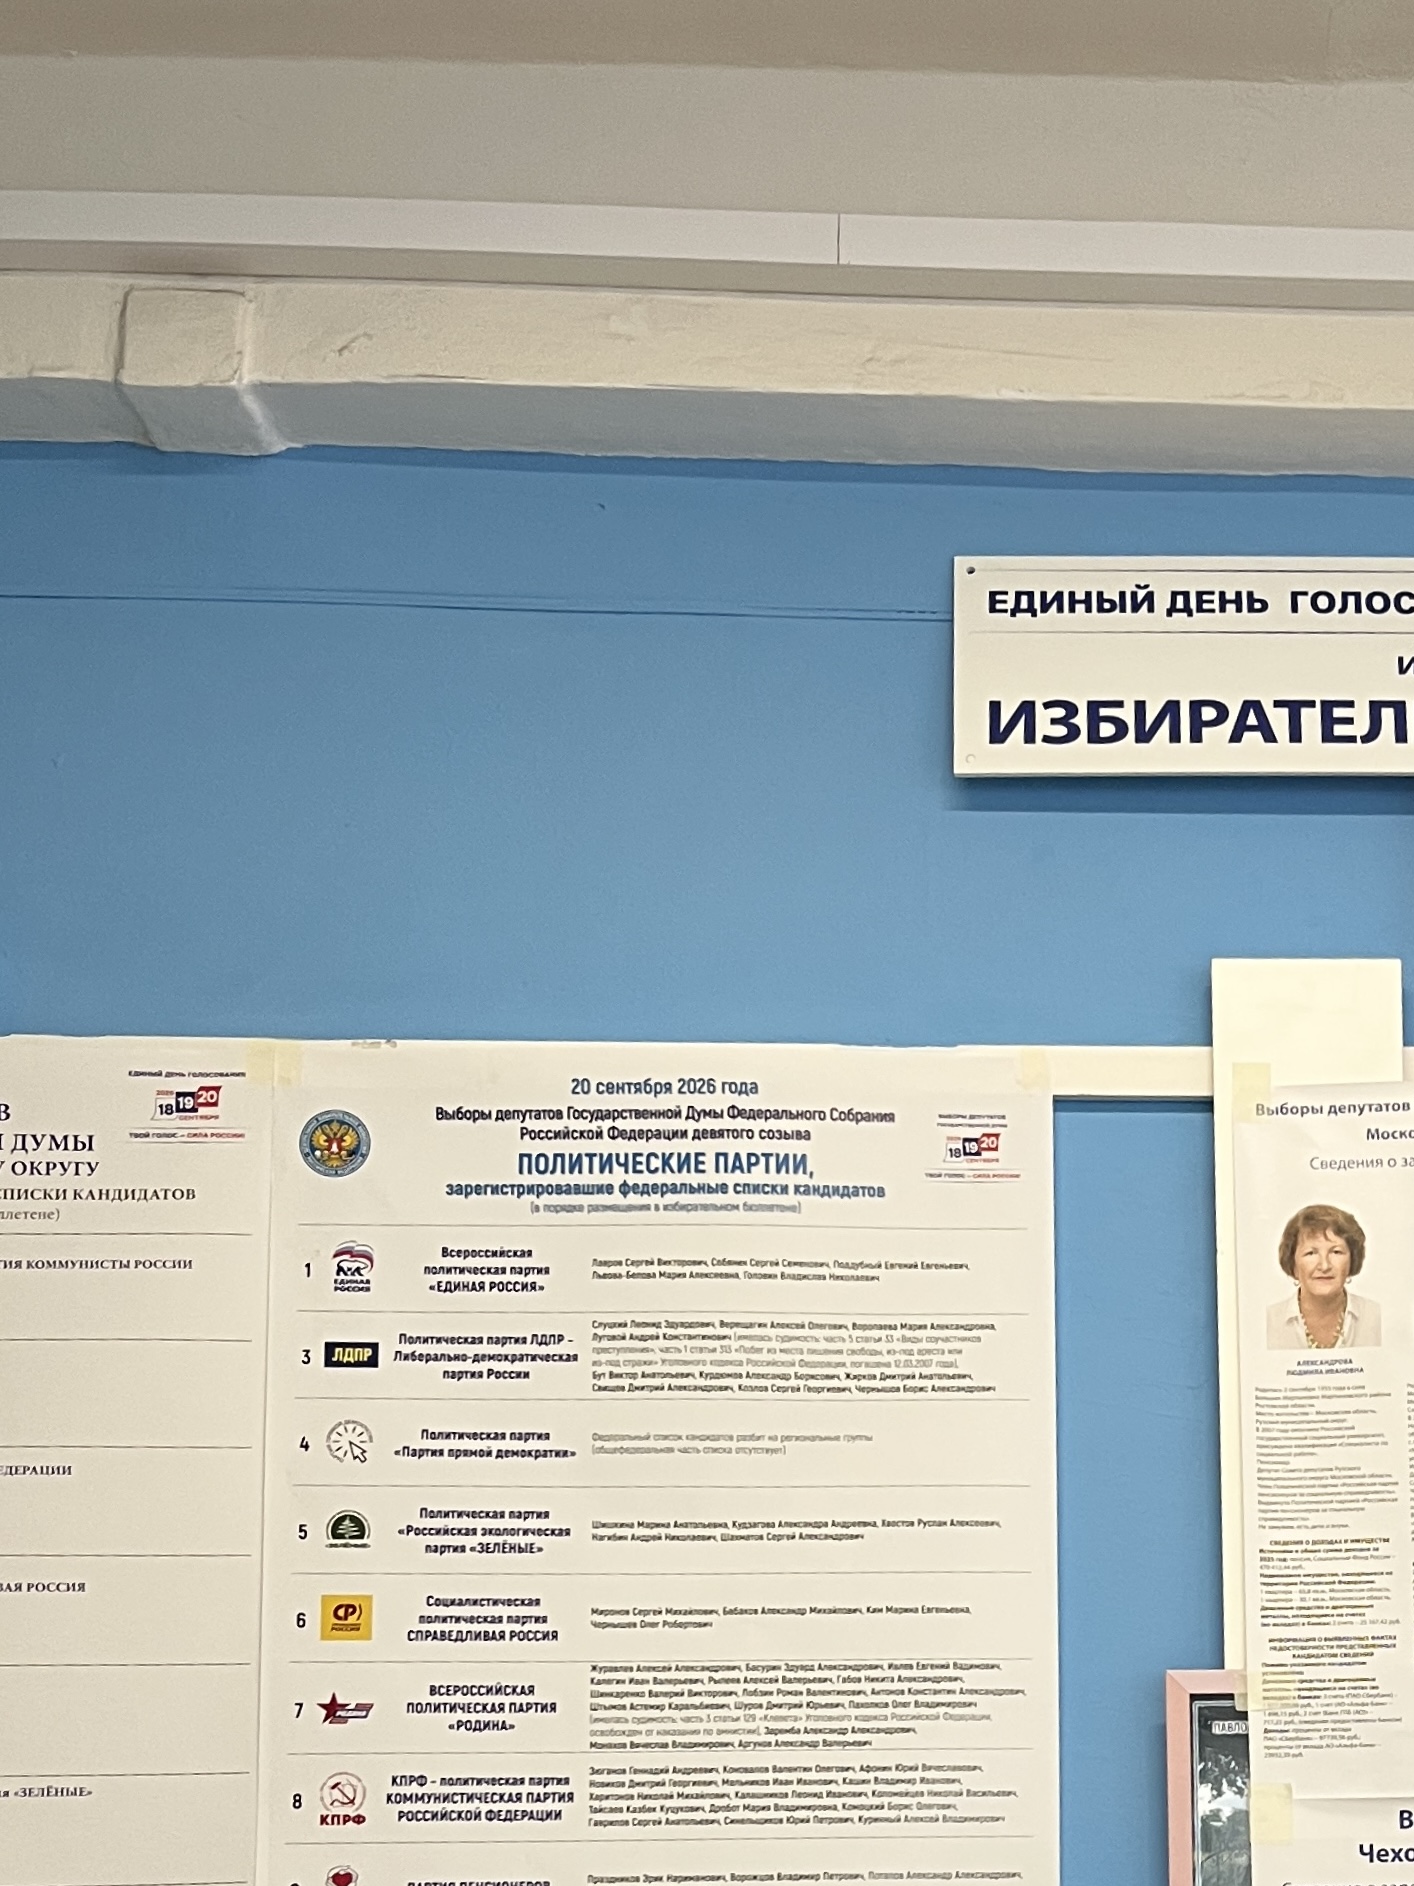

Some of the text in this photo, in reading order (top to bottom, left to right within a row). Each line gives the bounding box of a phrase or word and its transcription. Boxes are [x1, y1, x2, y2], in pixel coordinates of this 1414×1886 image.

[988, 586, 1154, 616] ЕДИНЫЙ
[1166, 590, 1268, 616] ДЕНЬ
[570, 1077, 759, 1097] 20 сентября 2026 года
[157, 1089, 218, 1116] 18 19 20
[1255, 1102, 1323, 1117] Выборы
[1326, 1101, 1411, 1116] депутатов
[435, 1105, 895, 1124] Выборы депутатов Государственной Думы Федерального Собрания
[519, 1125, 811, 1142] Российской Федерации девятого созыва
[9, 1133, 94, 1154] ДУМЫ
[10, 1160, 100, 1176] ОКРУГУ
[518, 1152, 813, 1177] ПОЛИТИЧЕСКИЕ ПАРТИИ,
[72, 1187, 196, 1202] КАНДИДАТОВ
[444, 1180, 886, 1199] зарегистрировавшие федеральные списки кандидатов
[440, 1246, 533, 1259] Всероссийская
[25, 1258, 193, 1269] КОММУНИСТЫ РОССИИ
[303, 1261, 311, 1278] 1
[427, 1280, 545, 1293] «ЕДИНАЯ РОССИЯ»
[397, 1332, 565, 1347] Политическая партия ЛДПР
[300, 1348, 311, 1365] 3
[331, 1346, 374, 1364] ЛДПР
[392, 1350, 579, 1364] Либерально-демократическая
[442, 1367, 530, 1381] партия России
[298, 1435, 310, 1452] 4
[393, 1445, 577, 1460] «Партия прямой демократии»
[297, 1523, 308, 1540] 5
[396, 1524, 571, 1541] «Российская экологическая
[424, 1539, 544, 1556] партия «ЗЕЛЁНЫЕ»
[26, 1581, 86, 1592] РОССИЯ
[425, 1595, 541, 1607] Социалистическая
[295, 1611, 306, 1628] 6
[406, 1629, 559, 1643] СПРАВЕДЛИВАЯ РОССИЯ
[428, 1682, 535, 1697] ВСЕРОССИЙСКАЯ
[293, 1701, 304, 1719] 7
[447, 1718, 516, 1732] «РОДИНА»
[13, 1784, 93, 1797] «ЗЕЛЁНЫЕ»
[385, 1791, 575, 1805] КОММУНИСТИЧЕСКАЯ ПАРТИЯ
[291, 1792, 303, 1809] 8
[319, 1813, 367, 1826] КПРФ
[397, 1806, 563, 1822] РОССИЙСКОЙ ФЕДЕРАЦИИ
